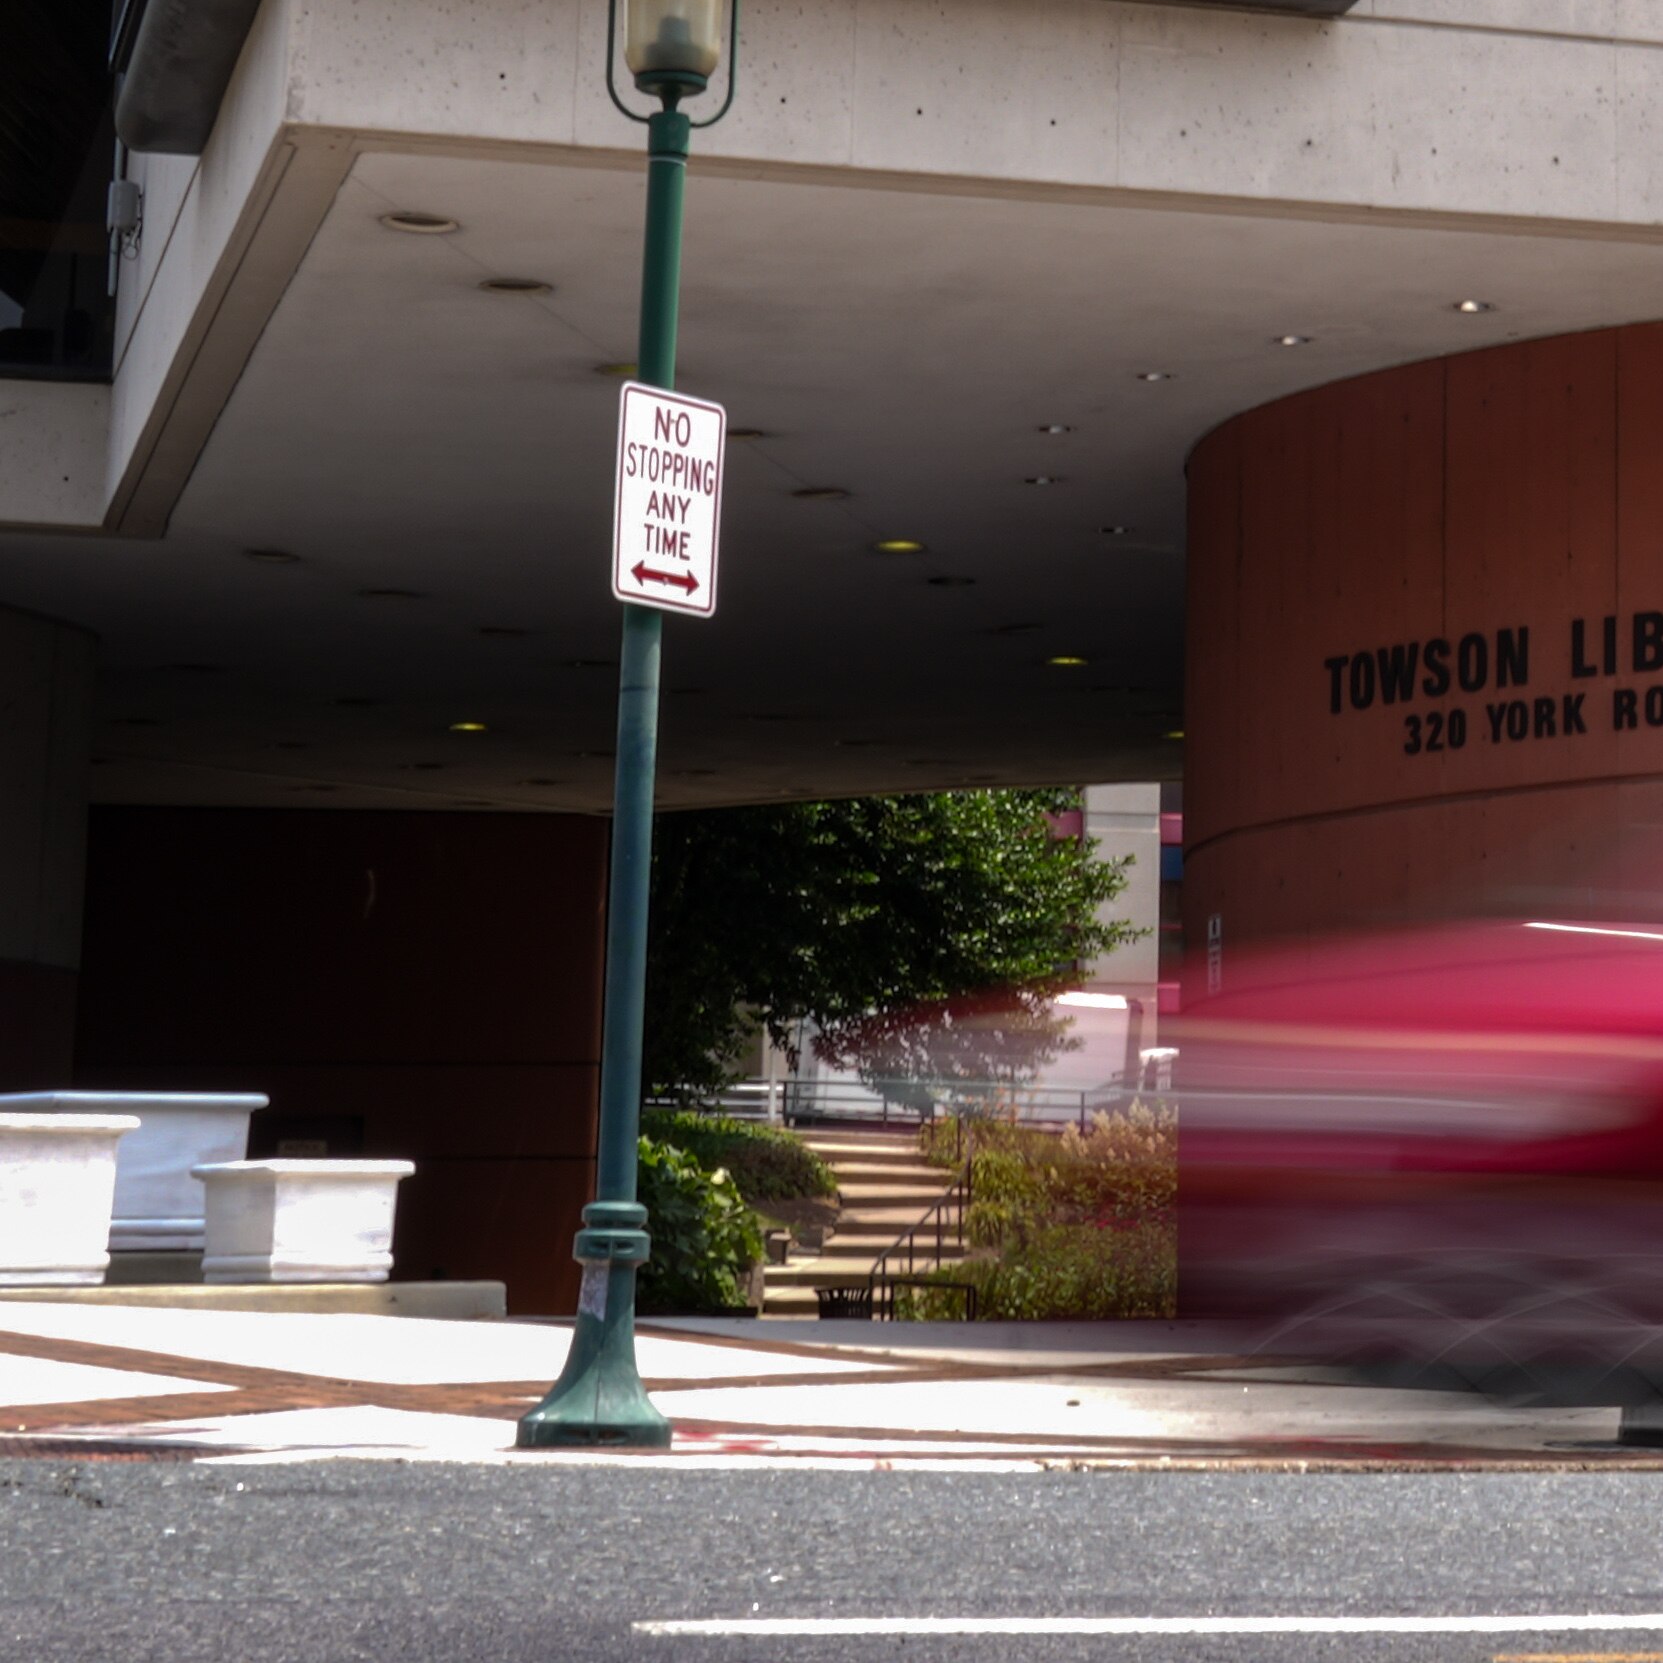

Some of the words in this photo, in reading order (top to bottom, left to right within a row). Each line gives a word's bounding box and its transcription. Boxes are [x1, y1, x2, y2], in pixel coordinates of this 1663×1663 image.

[654, 406, 691, 448] NO
[626, 441, 714, 496] STOPPING
[646, 490, 691, 525] ANY
[644, 523, 691, 561] TIME
[1325, 626, 1529, 715] TOWSON
[1403, 708, 1467, 756] 320
[1486, 693, 1586, 744] YORK
